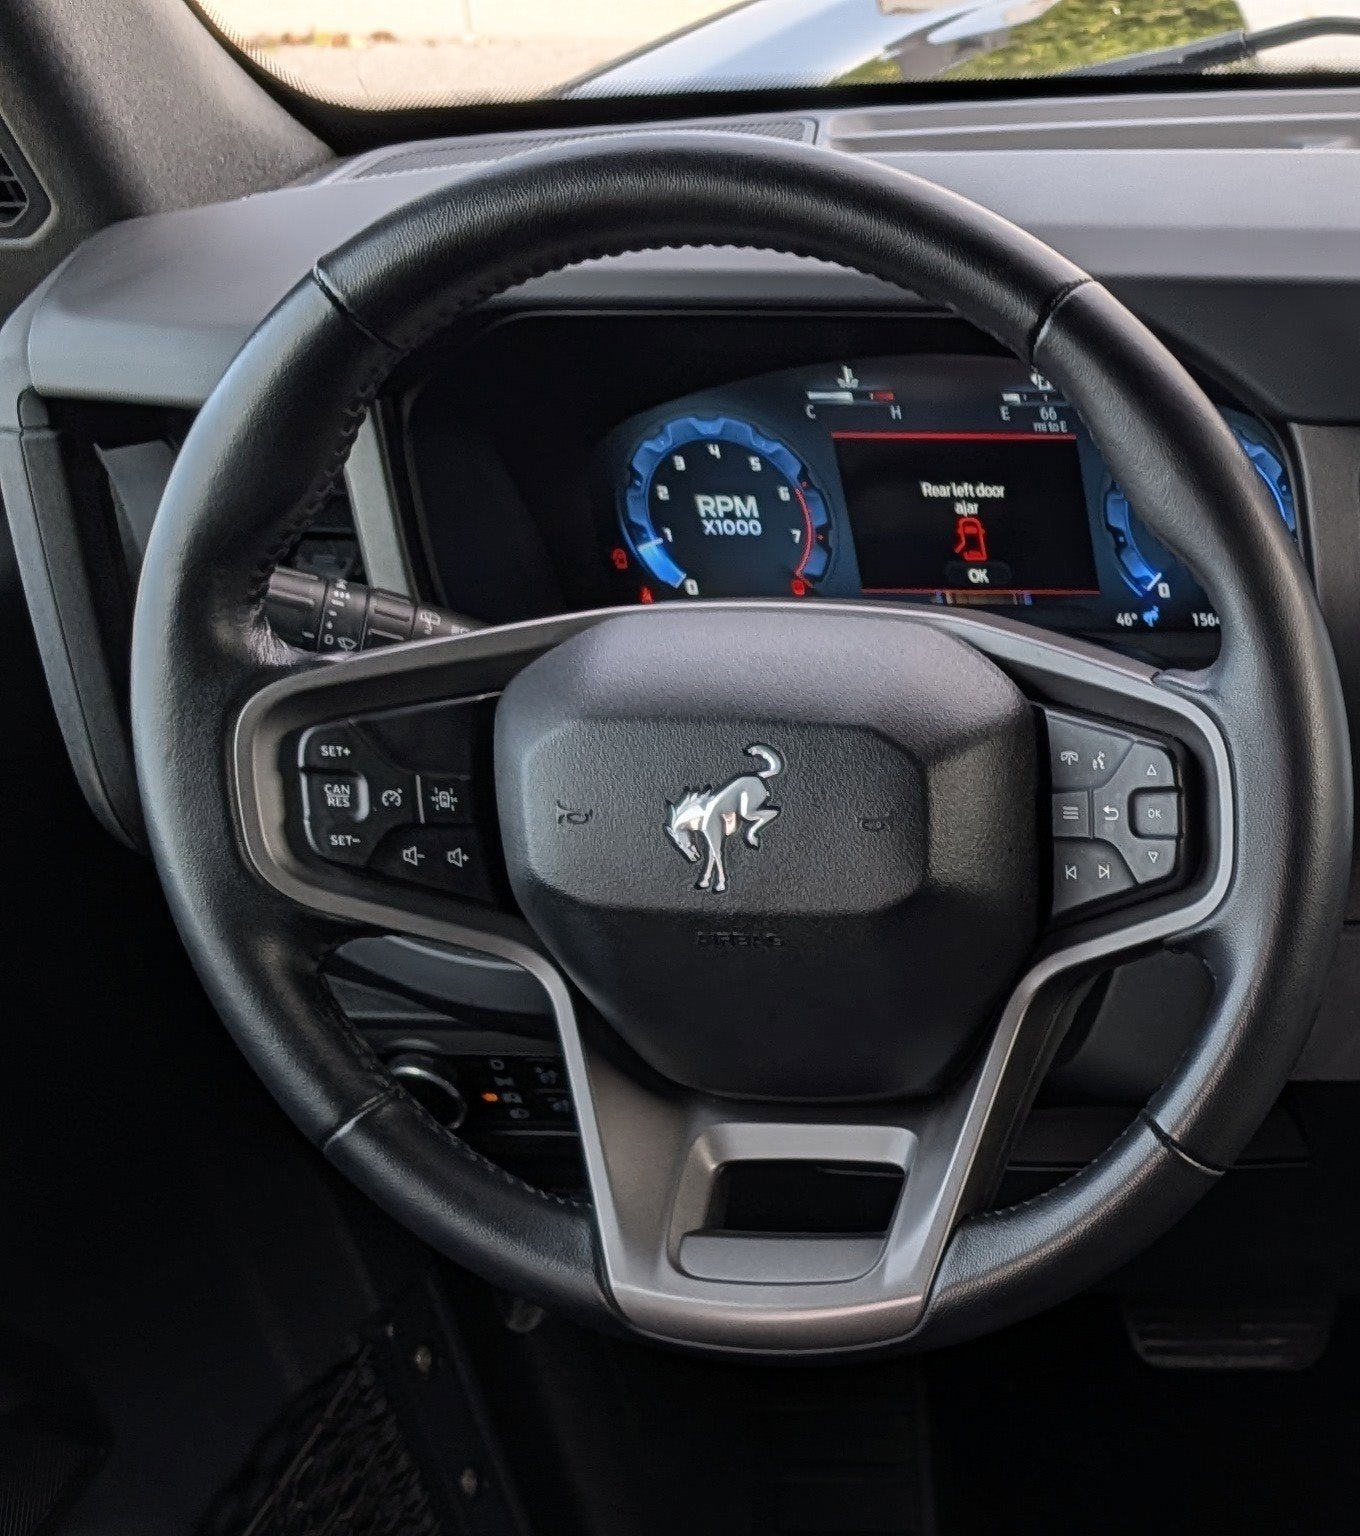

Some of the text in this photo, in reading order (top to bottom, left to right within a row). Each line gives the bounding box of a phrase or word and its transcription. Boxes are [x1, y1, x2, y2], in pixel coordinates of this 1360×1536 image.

[806, 404, 817, 419] C
[890, 405, 902, 420] H
[1000, 406, 1011, 421] E
[1040, 406, 1058, 421] 66
[707, 444, 721, 459] 4
[749, 455, 762, 471] 5
[656, 484, 670, 501] 2
[778, 486, 791, 502] 6
[920, 481, 1005, 498] Rear left door
[695, 495, 760, 518] RPM
[954, 500, 979, 517] ajar
[663, 527, 674, 543] 1
[702, 519, 762, 536] X1000
[790, 529, 801, 544] 7
[968, 568, 989, 583] OK
[320, 745, 351, 757] SET+
[324, 784, 350, 794] CAN
[1147, 808, 1162, 819] OK
